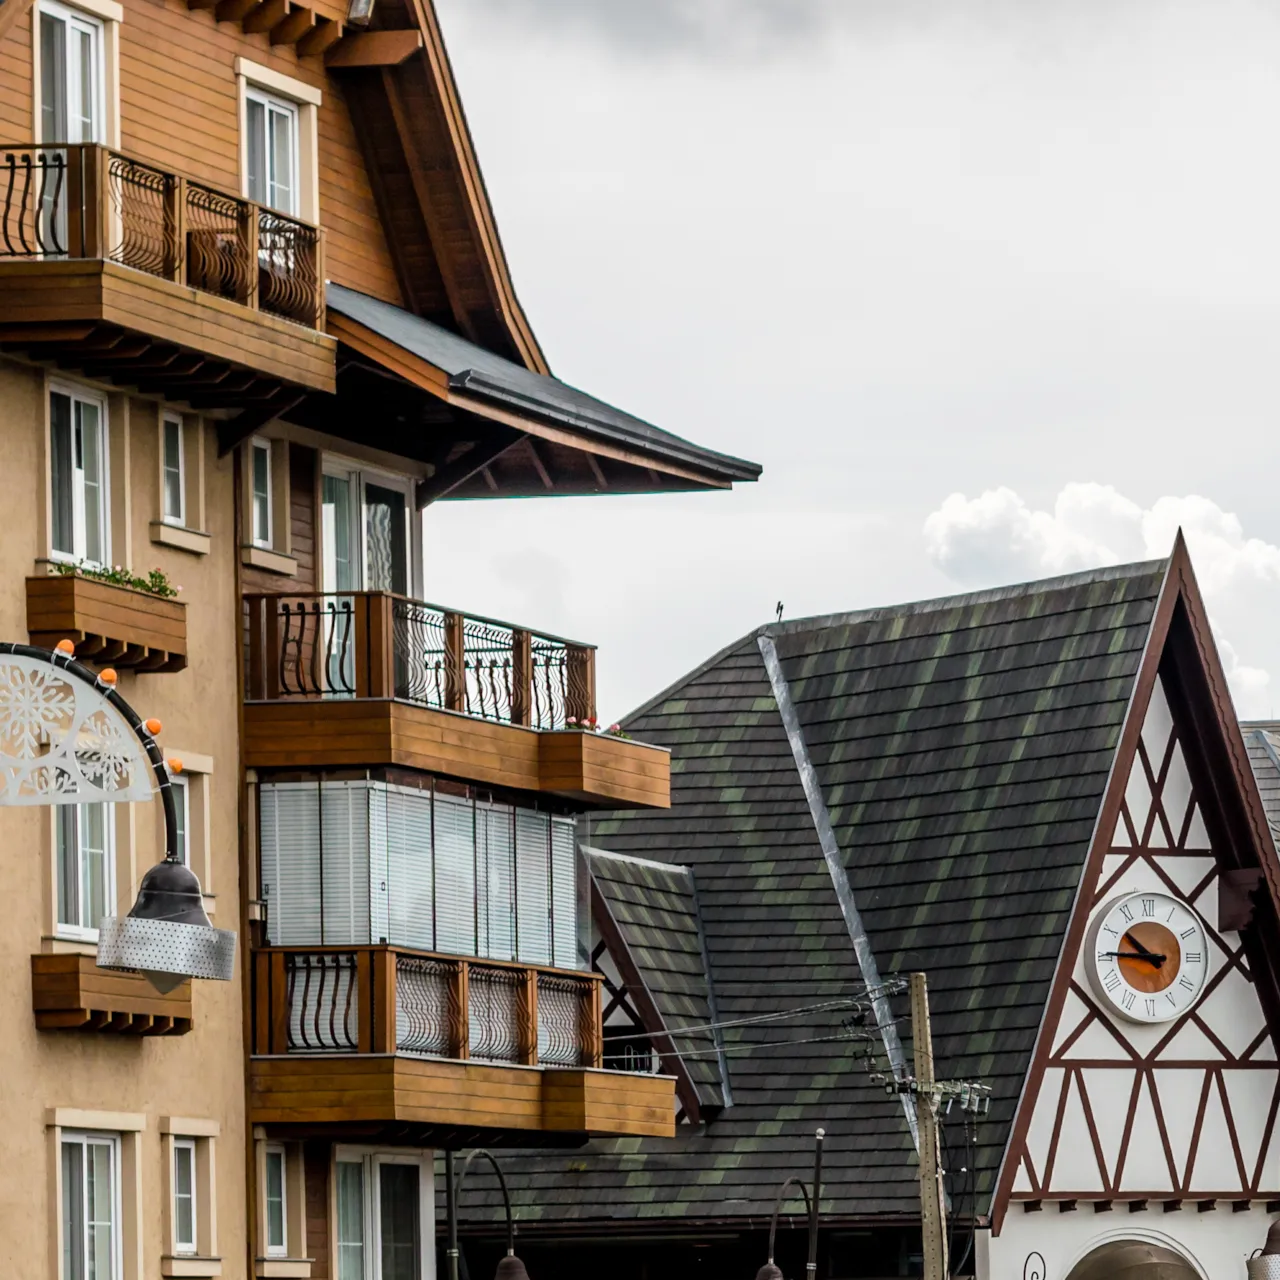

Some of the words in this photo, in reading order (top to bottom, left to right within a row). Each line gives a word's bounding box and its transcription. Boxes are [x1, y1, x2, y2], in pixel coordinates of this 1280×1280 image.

[1119, 904, 1134, 924] XI
[1142, 899, 1155, 917] XII
[1103, 924, 1119, 938] X
[1103, 969, 1122, 992] VIII
[1121, 989, 1137, 1011] VII
[1144, 999, 1156, 1017] VI
[1165, 992, 1177, 1008] V
